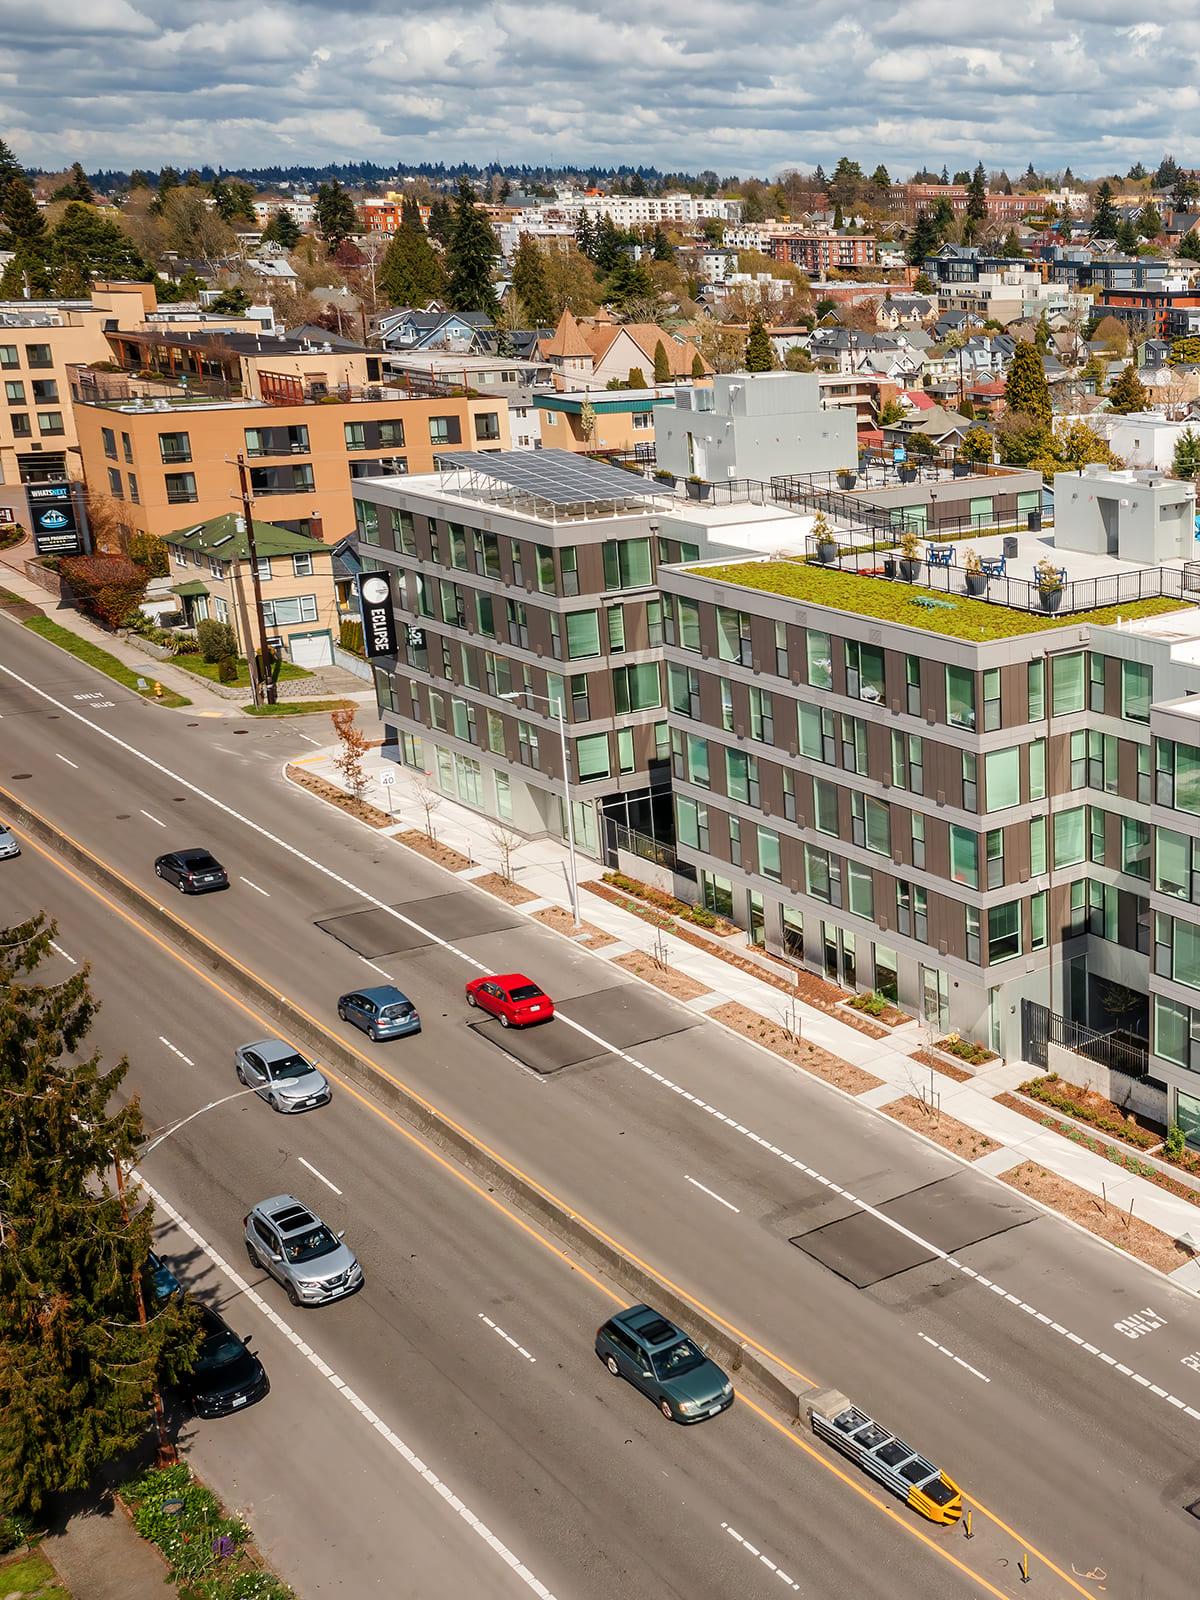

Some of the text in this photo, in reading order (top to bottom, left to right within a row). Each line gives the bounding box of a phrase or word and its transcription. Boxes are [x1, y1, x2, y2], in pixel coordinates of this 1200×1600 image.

[371, 608, 390, 652] ECLIPSE
[73, 692, 104, 700] ONLY
[90, 701, 116, 709] BUS
[1113, 1307, 1168, 1339] ONLY
